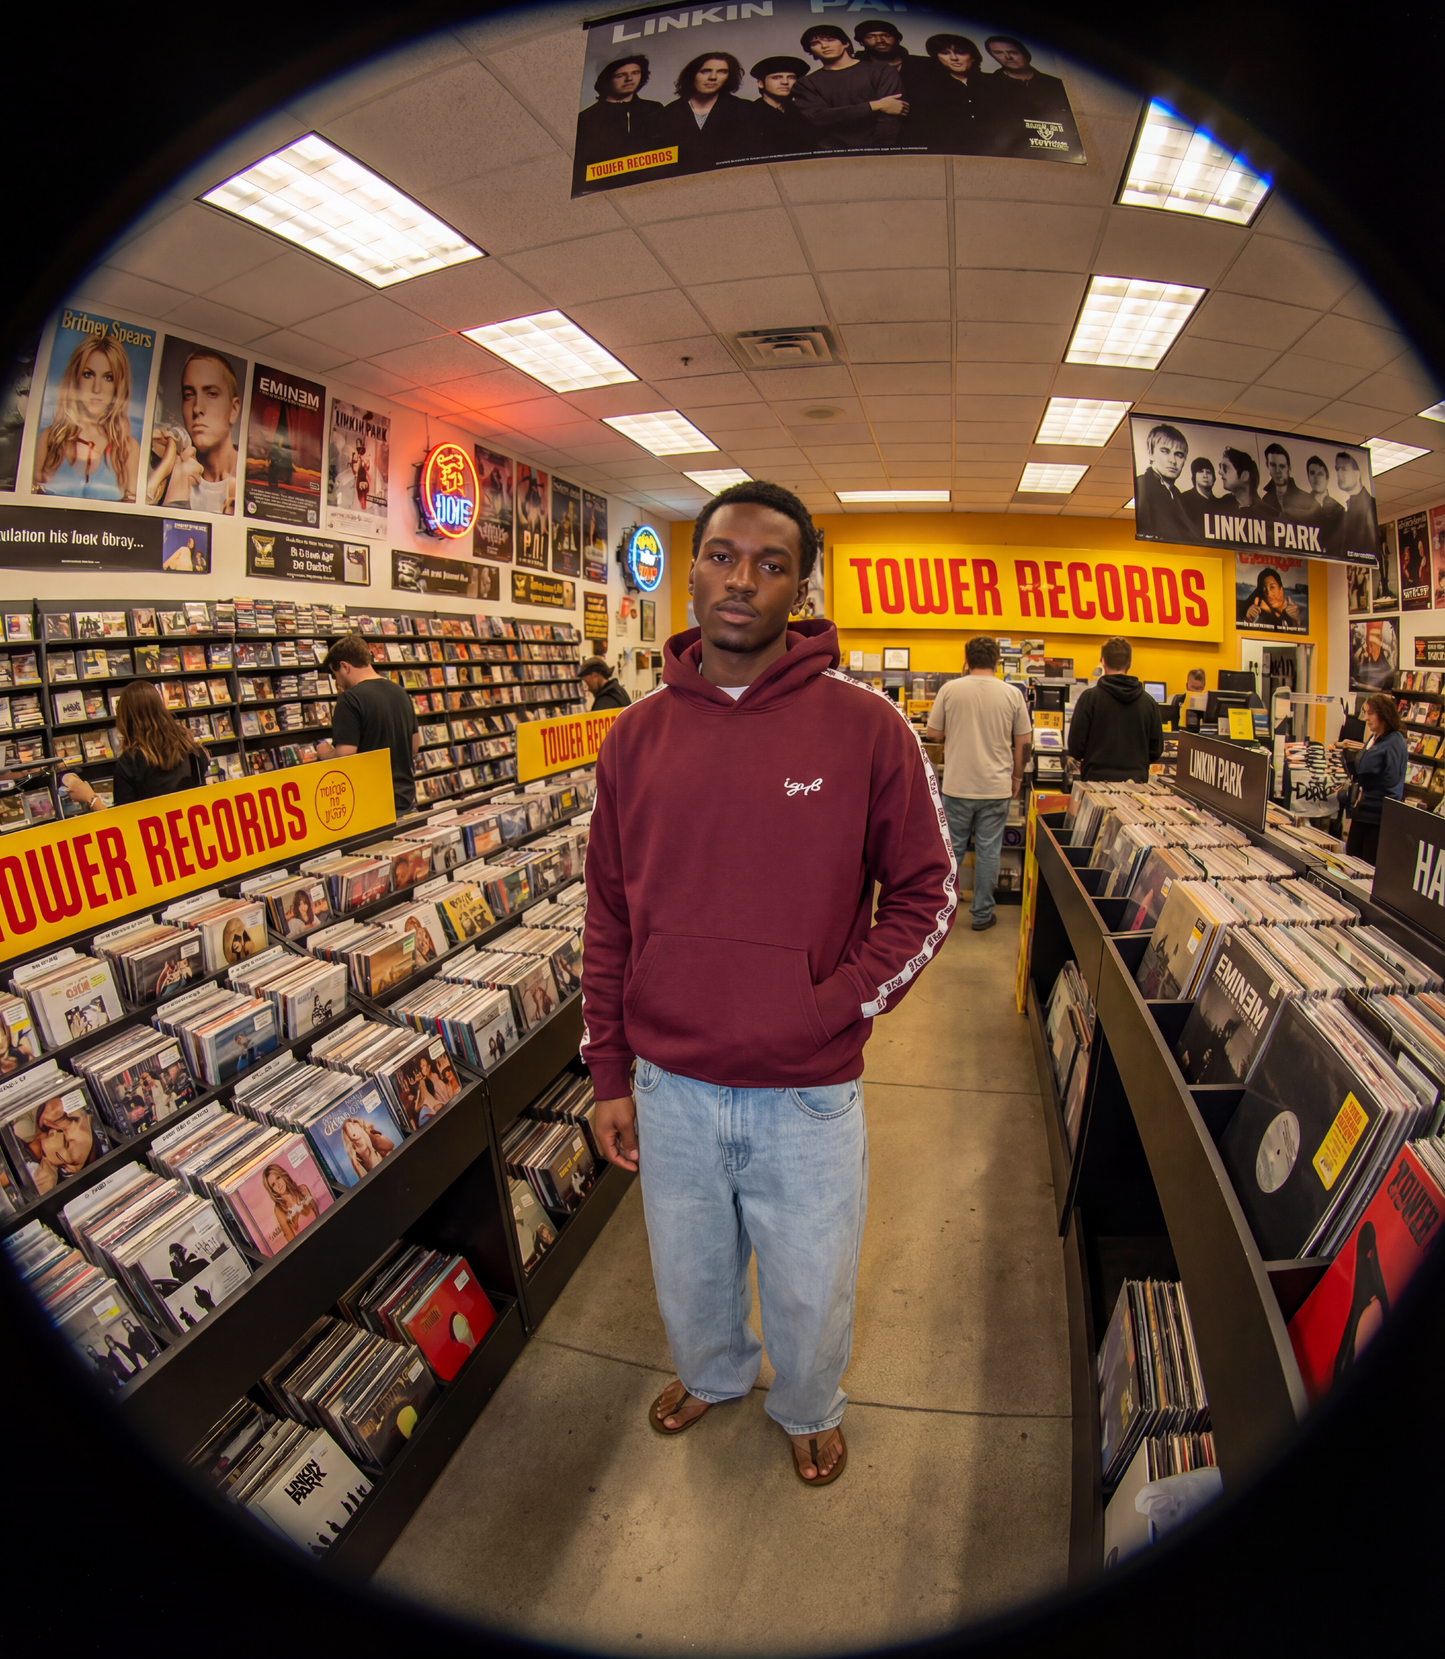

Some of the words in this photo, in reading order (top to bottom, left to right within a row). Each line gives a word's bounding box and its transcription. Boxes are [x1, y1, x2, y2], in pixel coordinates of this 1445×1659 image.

[612, 0, 774, 44] LINKIN
[590, 158, 625, 178] TOWER
[626, 149, 673, 170] RECORDS
[61, 309, 109, 340] Britney
[111, 320, 152, 348] Spears
[49, 529, 68, 544] his
[1204, 513, 1267, 545] LINKIN
[1274, 521, 1322, 553] PARK
[849, 557, 1005, 617] TOWER
[1014, 559, 1210, 627] RECORDS
[540, 722, 585, 767] TOWER
[1189, 748, 1217, 787] LINKIN
[1217, 756, 1244, 799] PARK
[0, 826, 137, 942] OWER
[138, 781, 308, 887] RECORDS
[1386, 1157, 1440, 1247] TOWER
[283, 1457, 319, 1497] LINKIN
[291, 1469, 328, 1506] PARK
